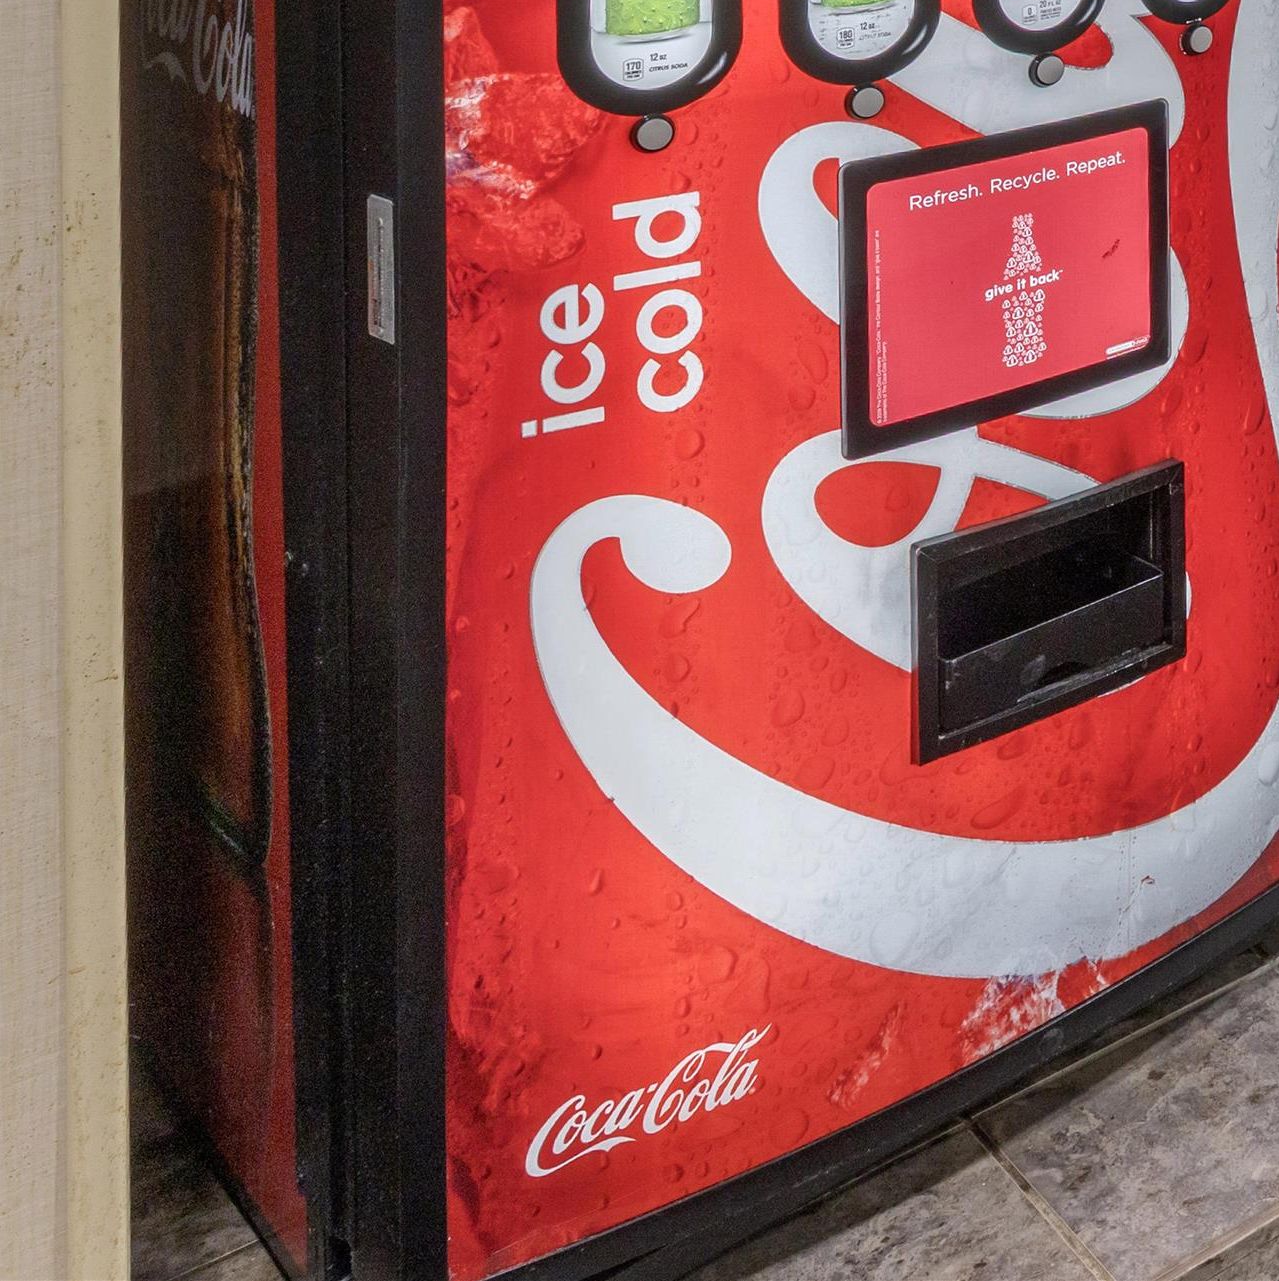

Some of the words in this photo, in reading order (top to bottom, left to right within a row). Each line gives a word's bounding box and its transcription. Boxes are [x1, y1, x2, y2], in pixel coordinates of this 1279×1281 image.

[859, 22, 868, 31] 12
[625, 60, 641, 71] 170
[649, 52, 659, 62] 12
[671, 61, 689, 70] SODA
[908, 182, 983, 211] Refresh.
[990, 166, 1060, 195] Recycle.
[1065, 150, 1126, 178] Repeat.
[612, 190, 704, 413] cold
[984, 280, 1013, 302] give
[1016, 277, 1027, 292] it
[1029, 269, 1061, 289] back
[521, 282, 606, 438] ice
[524, 1022, 773, 1178] Coca-Cola
